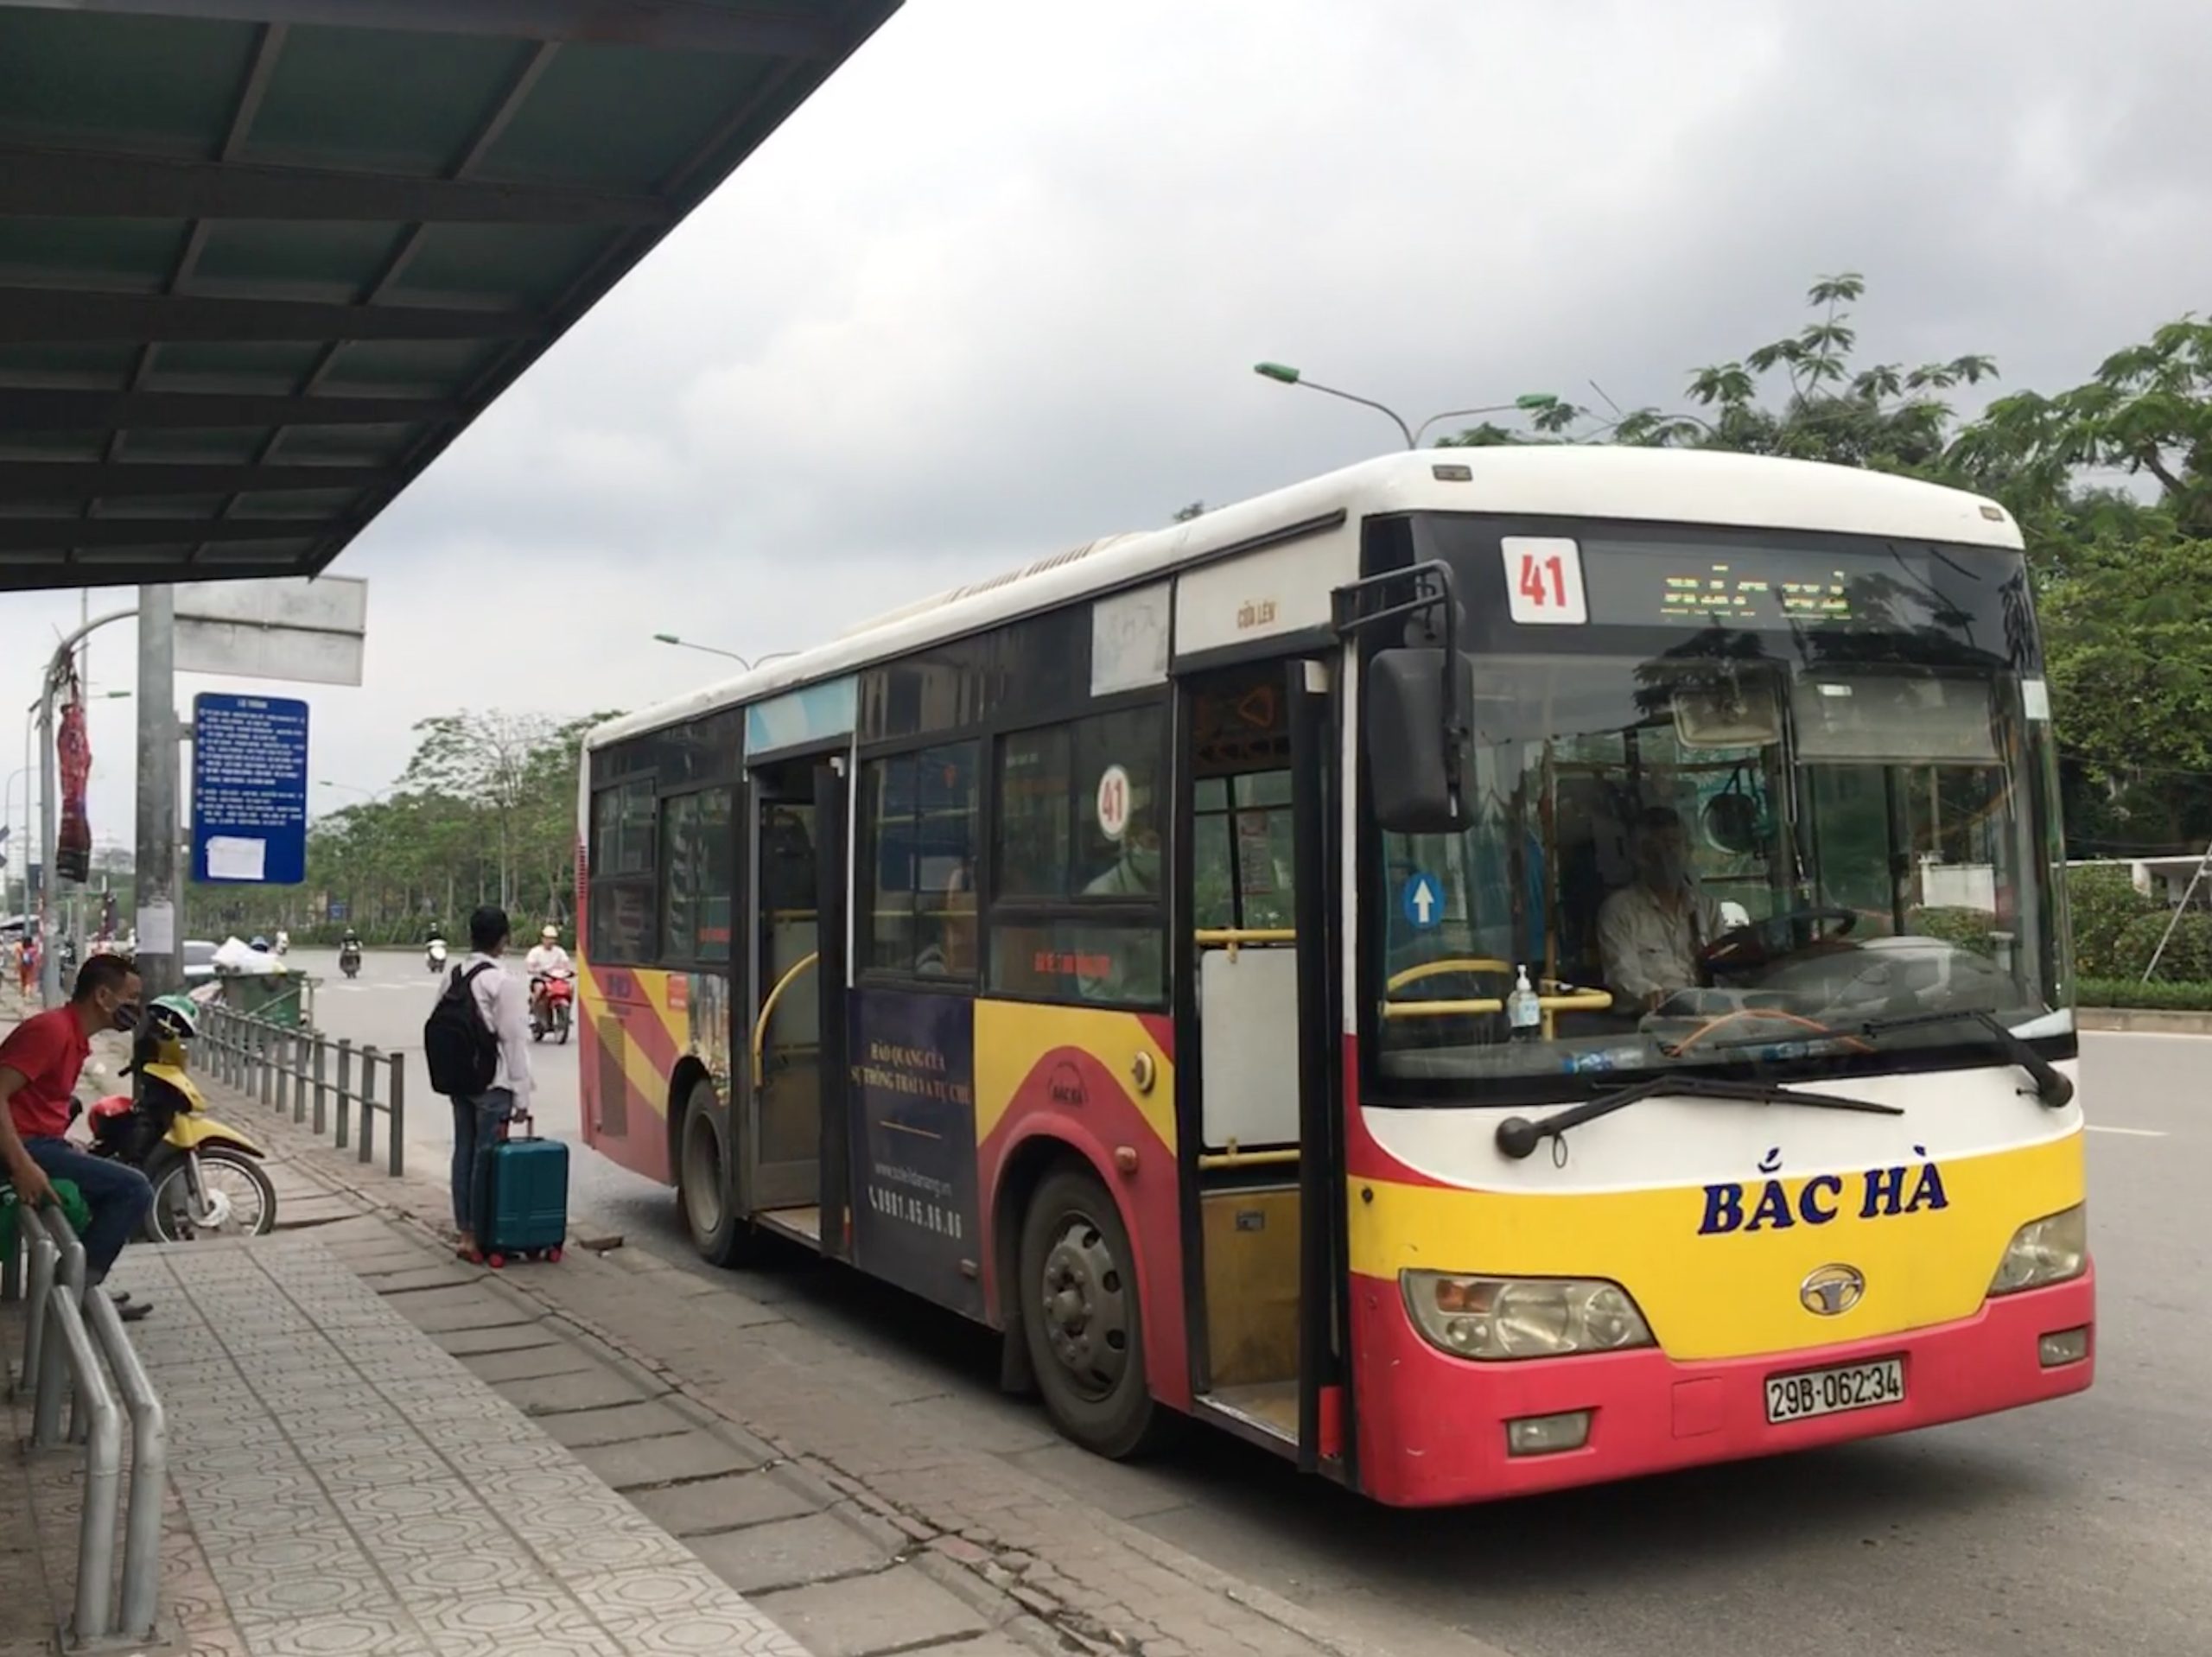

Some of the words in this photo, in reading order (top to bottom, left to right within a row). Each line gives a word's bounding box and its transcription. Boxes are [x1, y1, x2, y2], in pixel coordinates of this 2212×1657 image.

[1521, 554, 1566, 607] 41
[1102, 779, 1123, 822] 41
[1697, 1146, 1842, 1235] BẮC
[1859, 1145, 1949, 1219] HÀ
